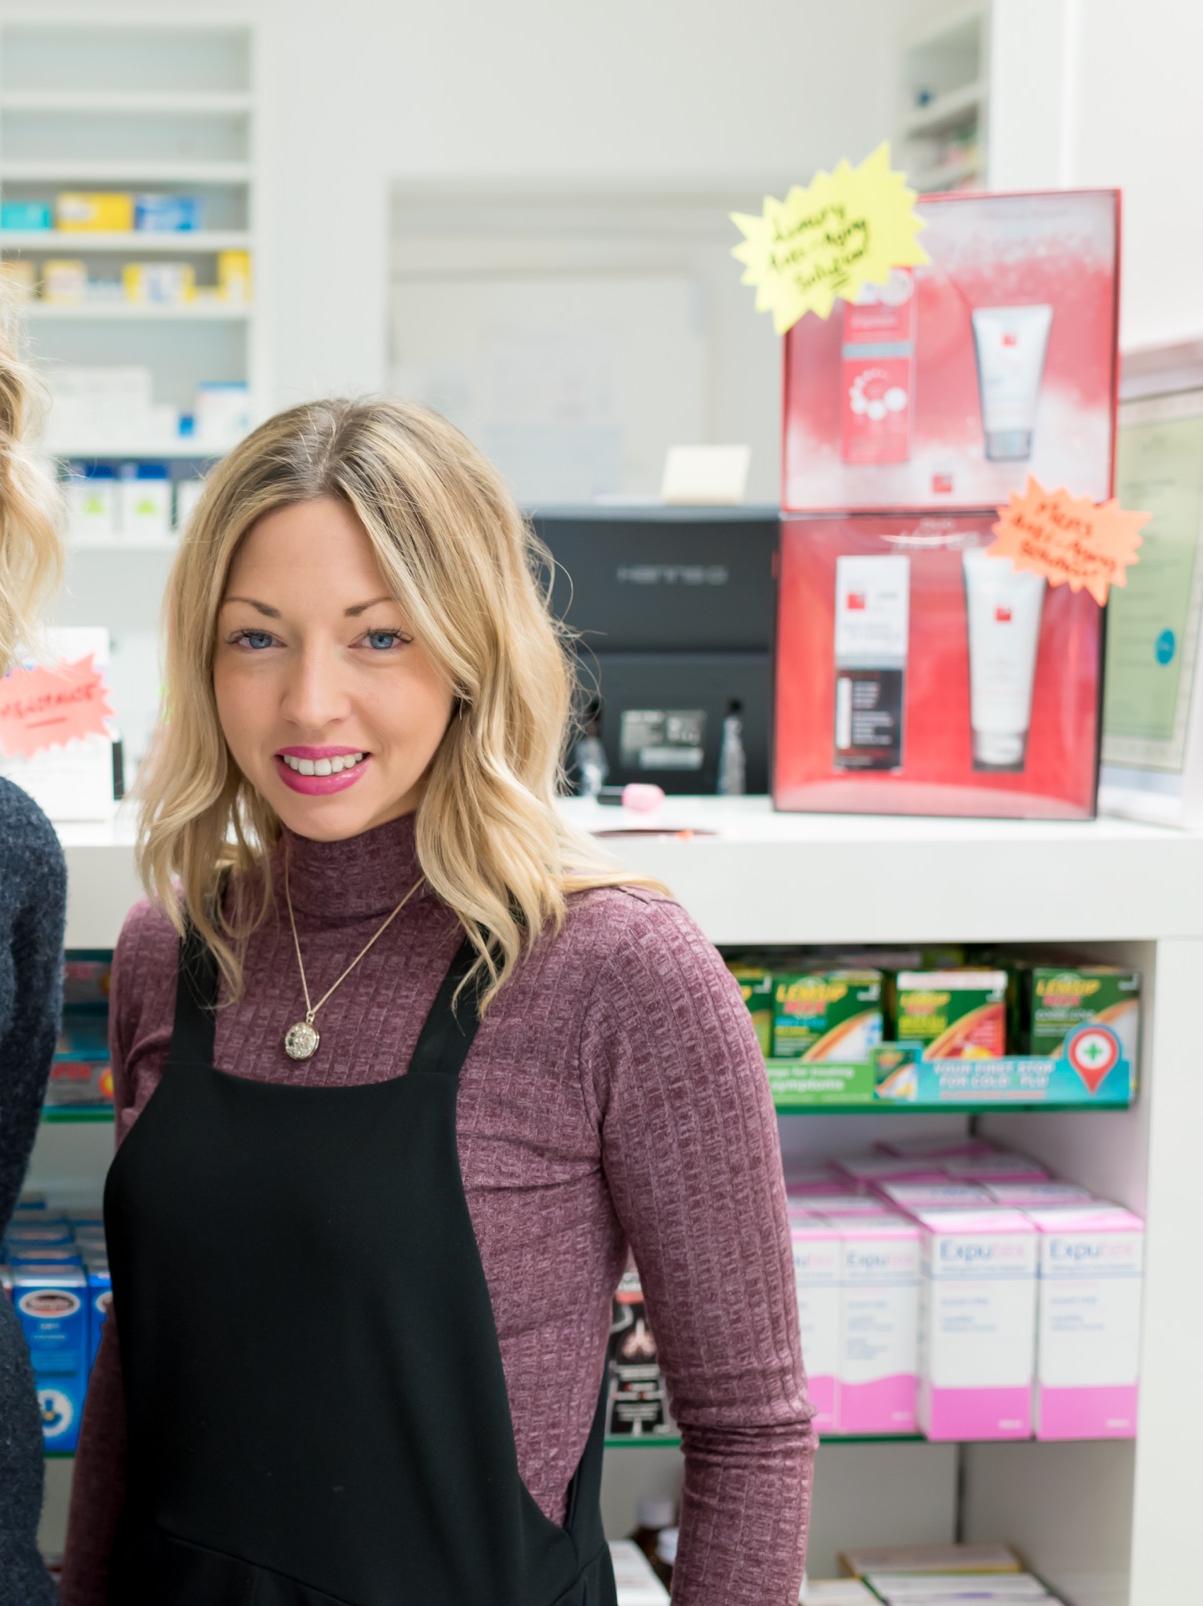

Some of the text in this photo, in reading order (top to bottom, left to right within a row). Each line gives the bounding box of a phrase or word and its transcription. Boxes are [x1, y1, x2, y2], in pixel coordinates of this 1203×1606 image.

[934, 1061, 970, 1074] YOUR
[939, 1075, 967, 1088] FOR
[971, 1074, 1009, 1088] COLD
[940, 1239, 1026, 1264] Exputex
[1050, 1238, 1135, 1263] Exputex
